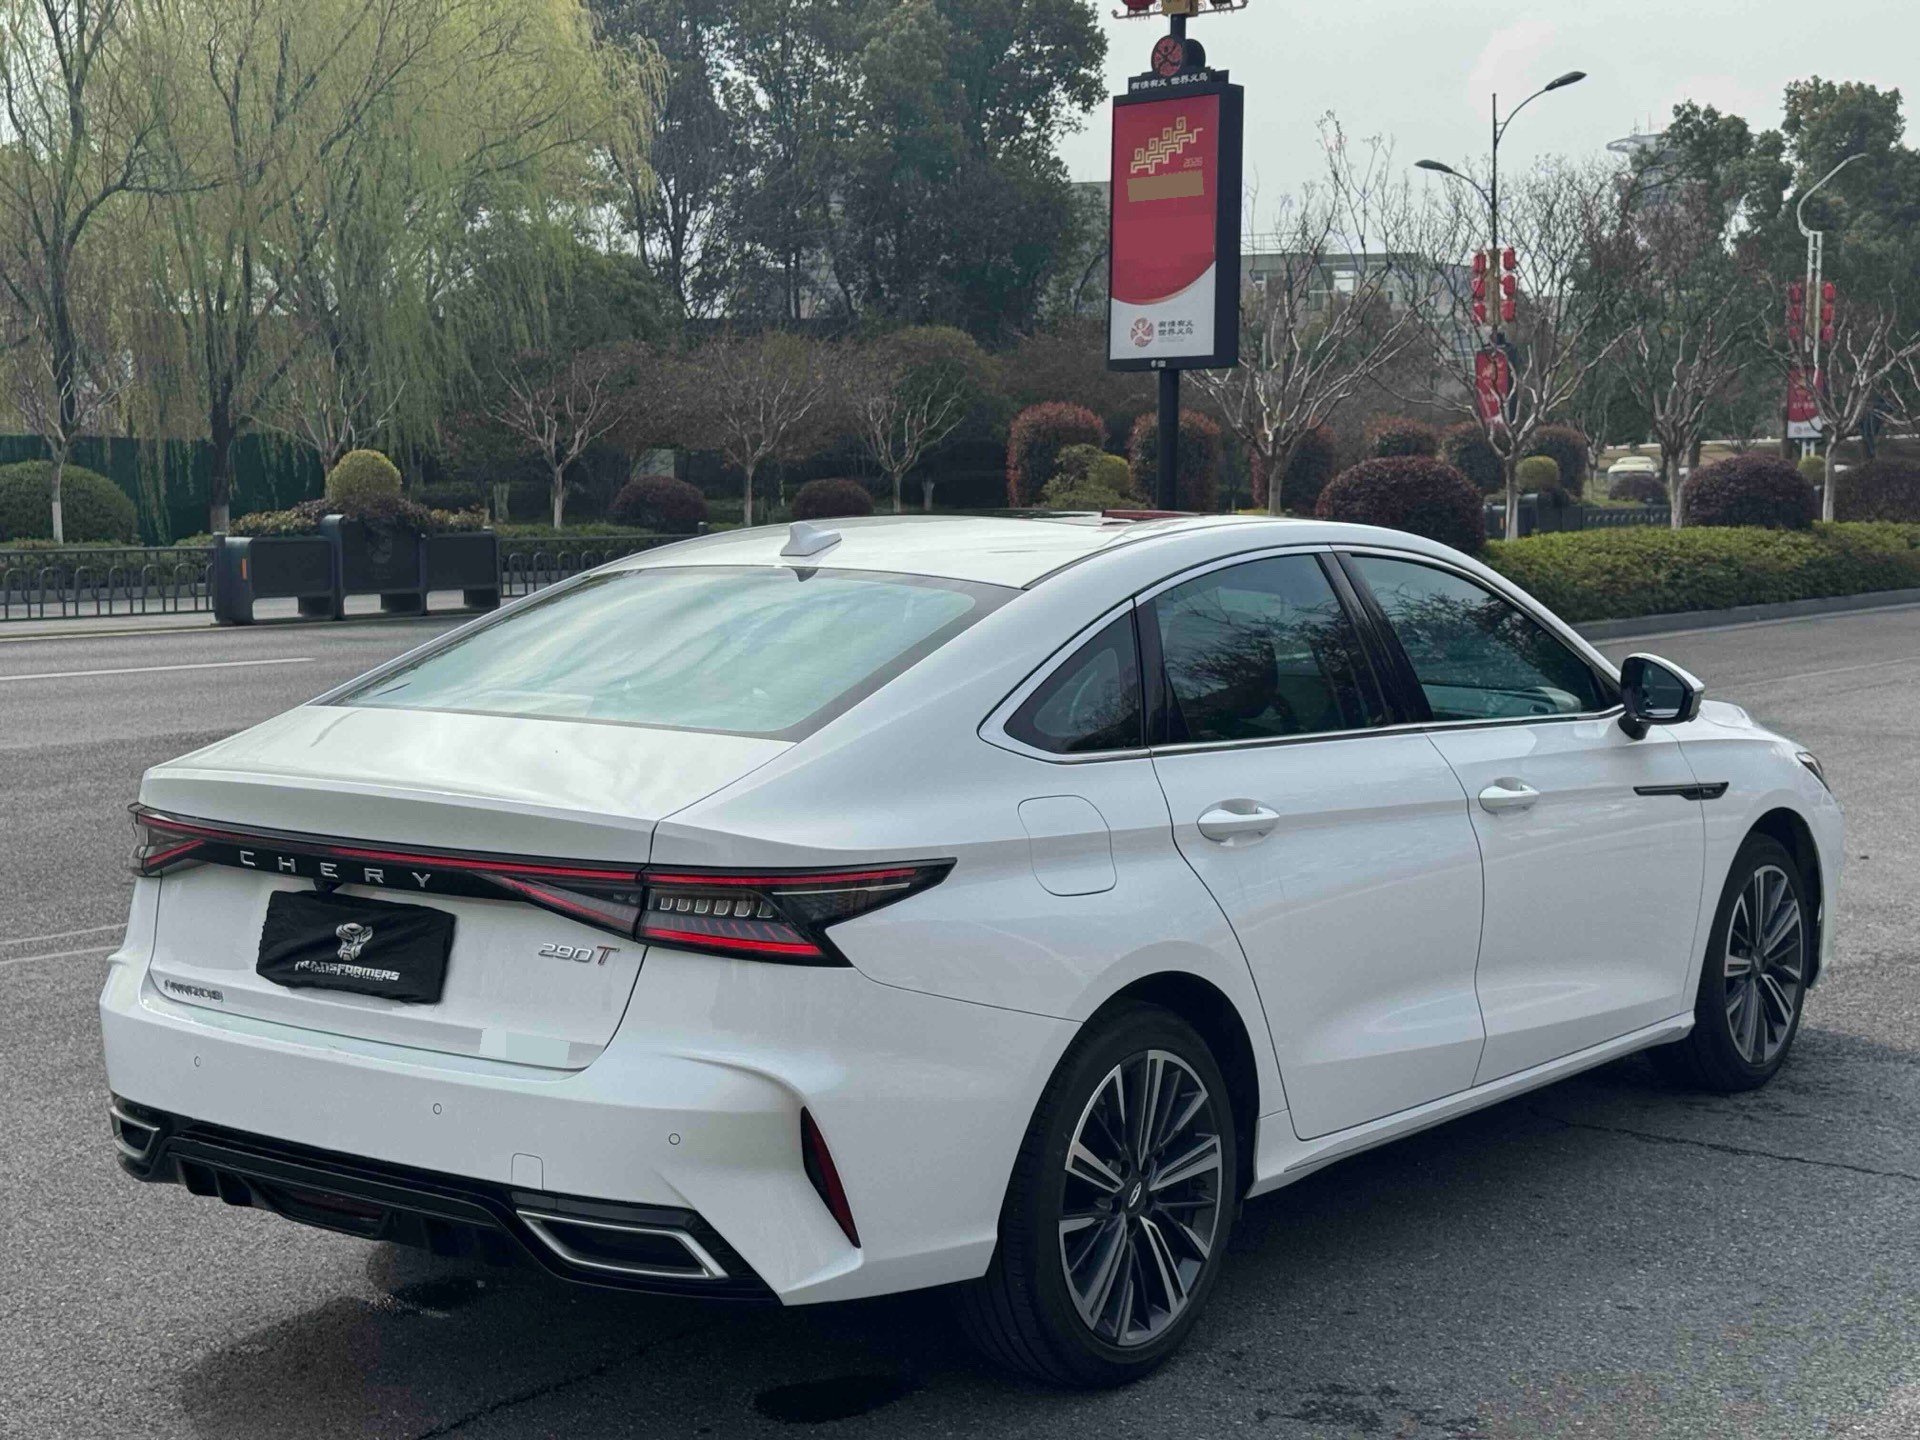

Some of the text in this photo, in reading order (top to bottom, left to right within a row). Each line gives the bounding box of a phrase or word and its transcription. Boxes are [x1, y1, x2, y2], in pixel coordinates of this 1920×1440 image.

[239, 850, 431, 888] CHERY
[538, 942, 620, 966] 290T
[294, 960, 400, 982] TRANSFORMERS
